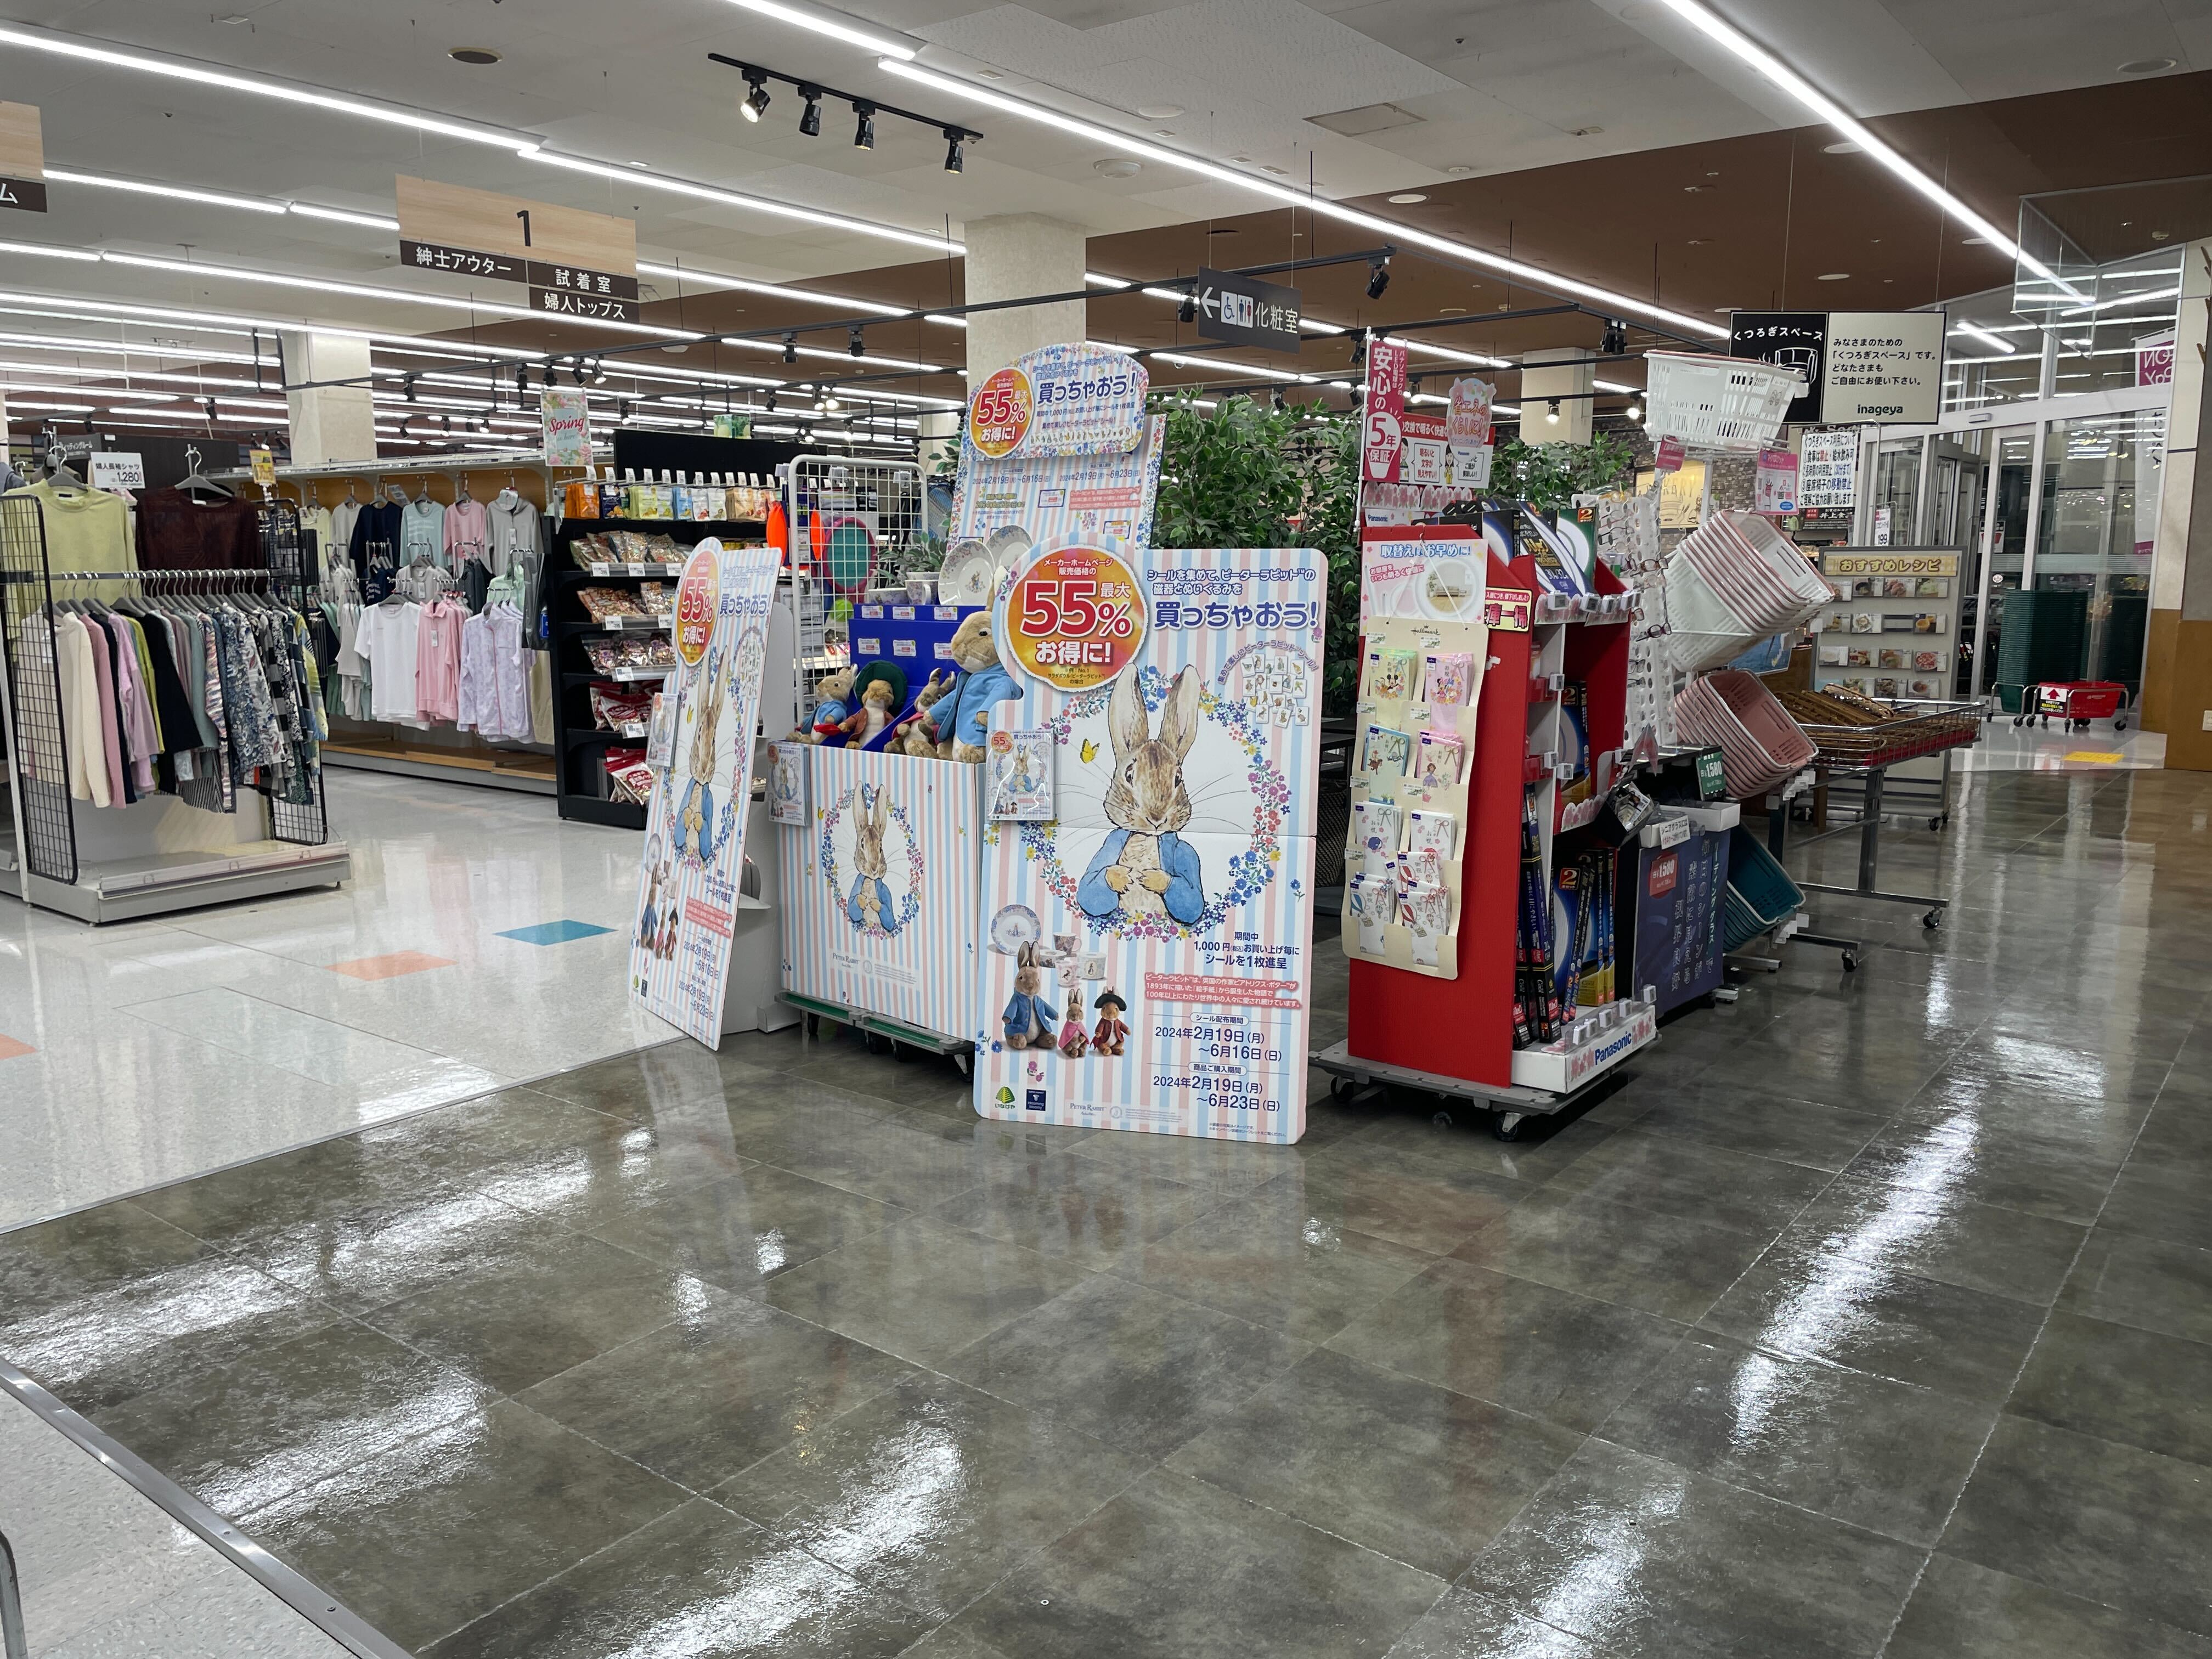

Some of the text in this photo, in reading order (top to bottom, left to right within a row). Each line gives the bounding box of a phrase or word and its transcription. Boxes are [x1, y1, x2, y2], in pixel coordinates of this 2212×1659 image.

[516, 210, 532, 247] 1
[415, 246, 512, 275] 紳士アウター
[555, 269, 612, 294] 試着室
[544, 292, 626, 320] 婦人トップス
[1255, 301, 1299, 334] 化粧室
[1734, 326, 1824, 341] くつろぎスペース
[1833, 338, 1903, 347] みなさまのための
[1832, 350, 1937, 361] 「くつろぎスペース」です。
[1832, 363, 1884, 373] どなたさまも
[1371, 346, 1393, 409] 安心の
[1831, 376, 1922, 386] ご自由にお使い下さい。
[976, 389, 1027, 426] 55%
[1454, 394, 1488, 416] 省エネの
[1857, 404, 1904, 416] inageya
[549, 415, 585, 436] Spring
[1369, 449, 1391, 464] 保証
[1368, 514, 1389, 522] Panasonic
[1581, 509, 1593, 519] 2
[1043, 557, 1114, 567] メーカーホームページ
[1839, 558, 1942, 572] おすすめレシピ
[1058, 567, 1097, 575] 販売価格の
[1099, 582, 1131, 599] 最大
[1152, 583, 1243, 596] 磁器とぬいぐるみを
[680, 578, 714, 623] 55%
[1020, 580, 1133, 637] 55%
[1153, 601, 1319, 629] 買っちゃおう!
[1035, 640, 1112, 665] お得に!
[1564, 687, 1576, 703] 2
[1562, 869, 1577, 885] 2
[1234, 932, 1259, 941] 期間中
[1205, 953, 1288, 969] シールを1枚進呈
[1195, 1014, 1244, 1024] シール配布期間
[1595, 1031, 1632, 1066] Panasonic
[1193, 1063, 1242, 1074] 商品ご購入期間
[1070, 1102, 1086, 1111] PETER
